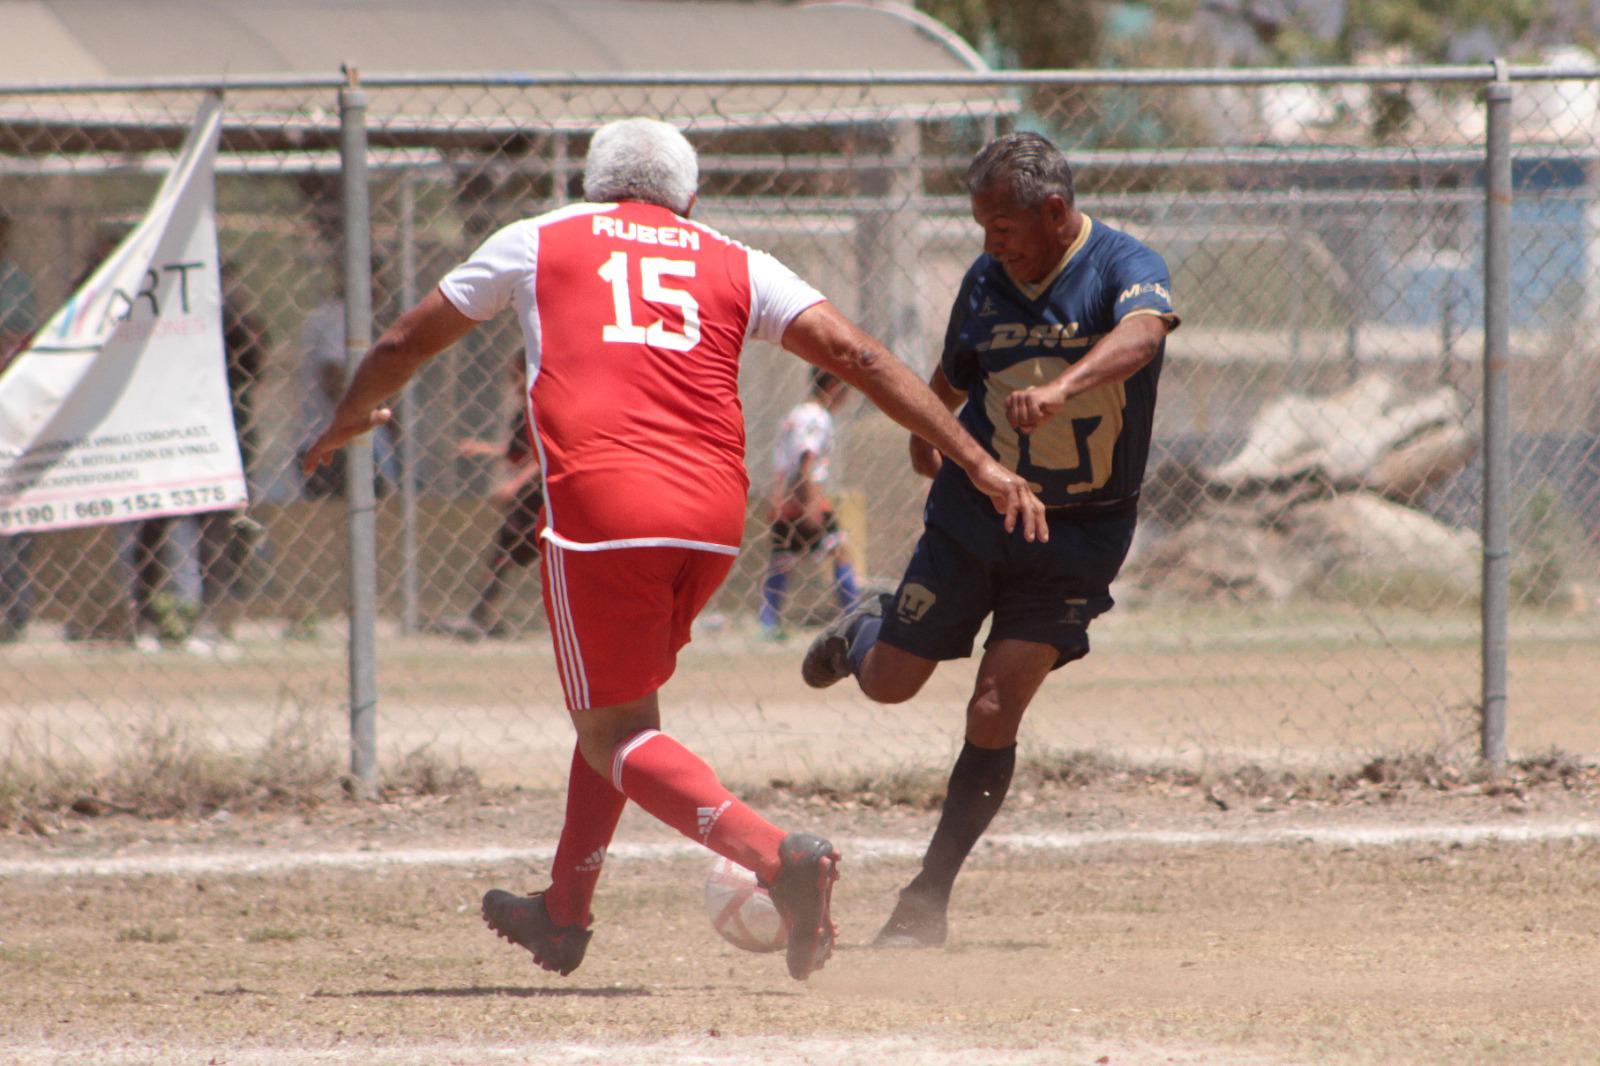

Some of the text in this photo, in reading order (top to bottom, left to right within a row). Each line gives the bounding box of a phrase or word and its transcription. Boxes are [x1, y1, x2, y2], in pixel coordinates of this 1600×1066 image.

[592, 214, 700, 251] RUBEN
[597, 250, 701, 352] 15
[75, 499, 113, 518] 669
[122, 493, 161, 511] 152
